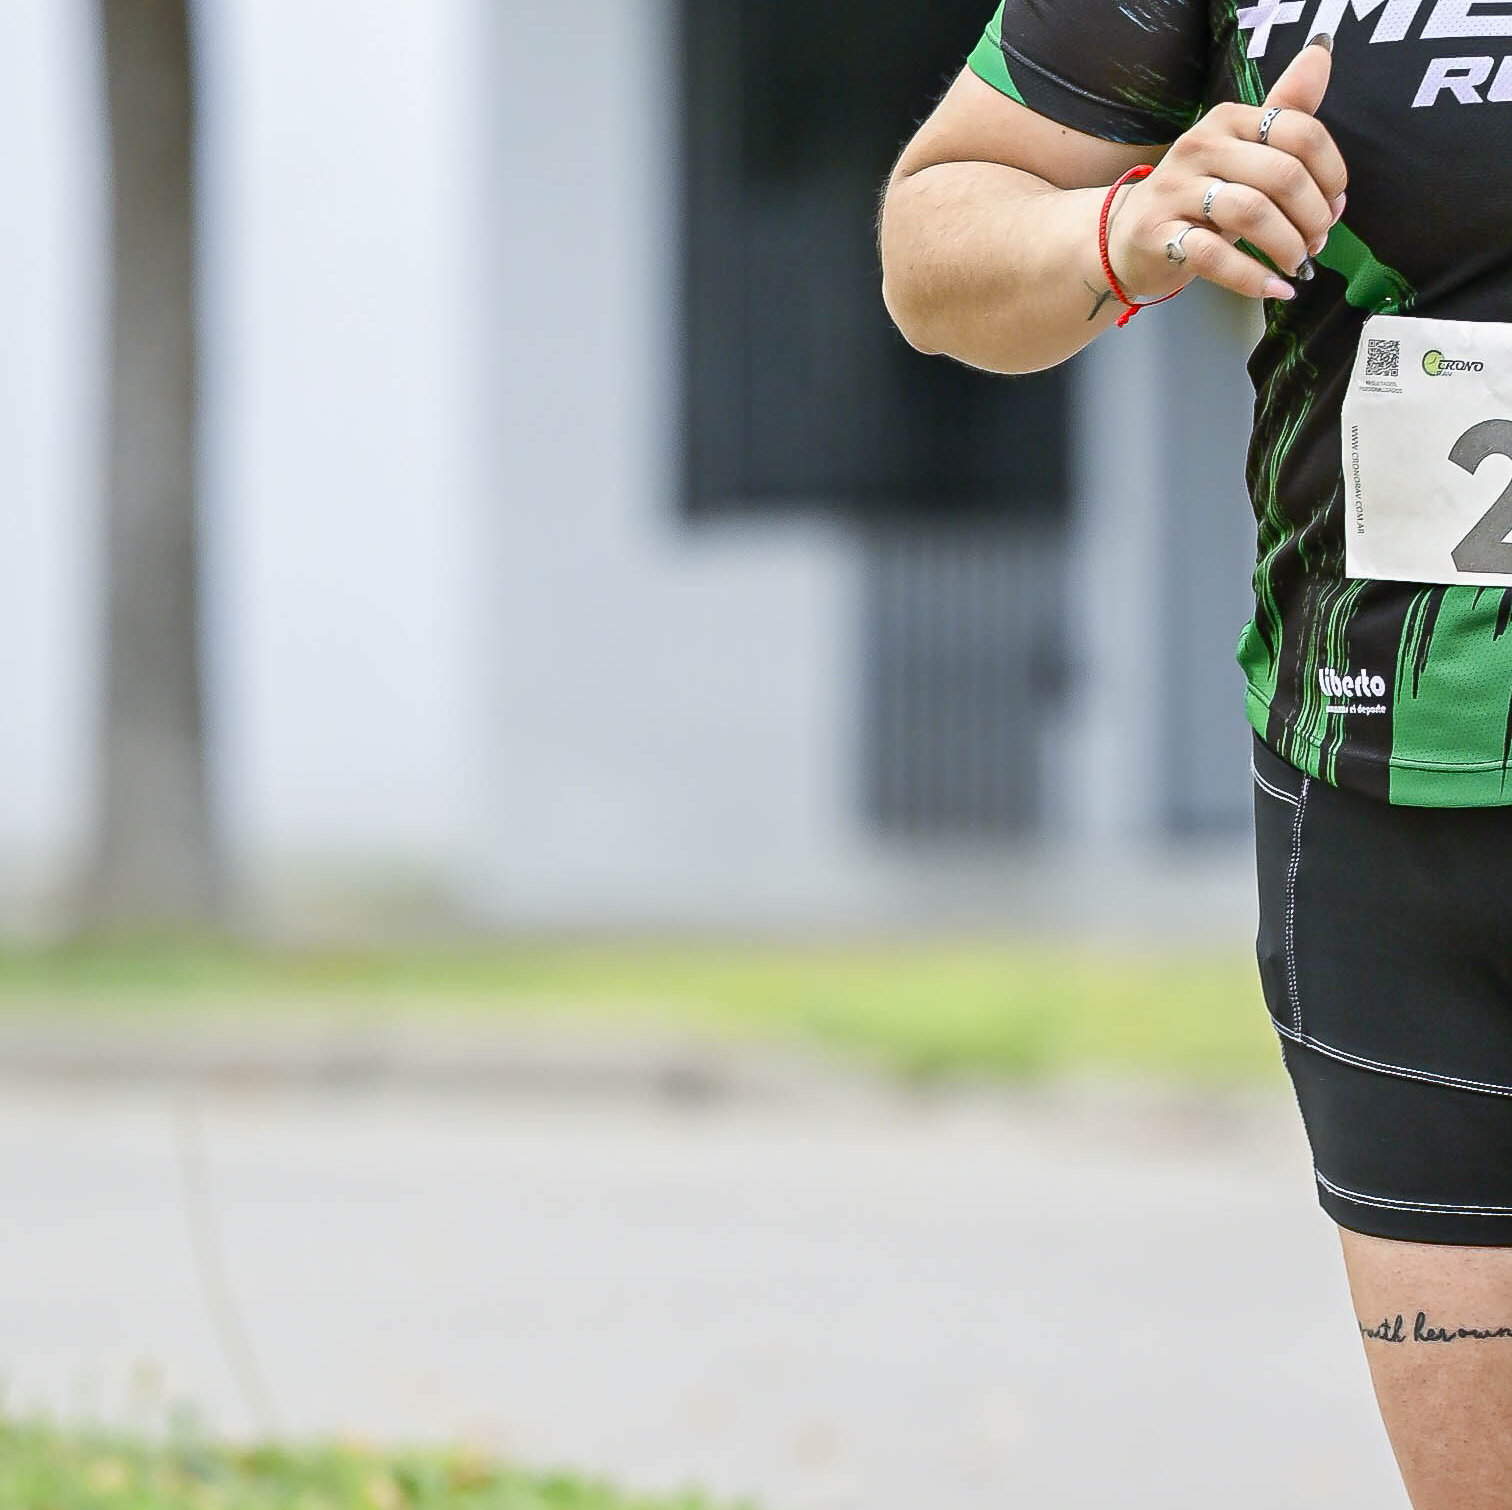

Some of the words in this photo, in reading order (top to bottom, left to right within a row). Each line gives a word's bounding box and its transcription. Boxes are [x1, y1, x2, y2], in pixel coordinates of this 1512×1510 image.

[1437, 359, 1484, 372] CRONO
[1318, 666, 1386, 698] liberto
[1413, 1311, 1456, 1343] her
